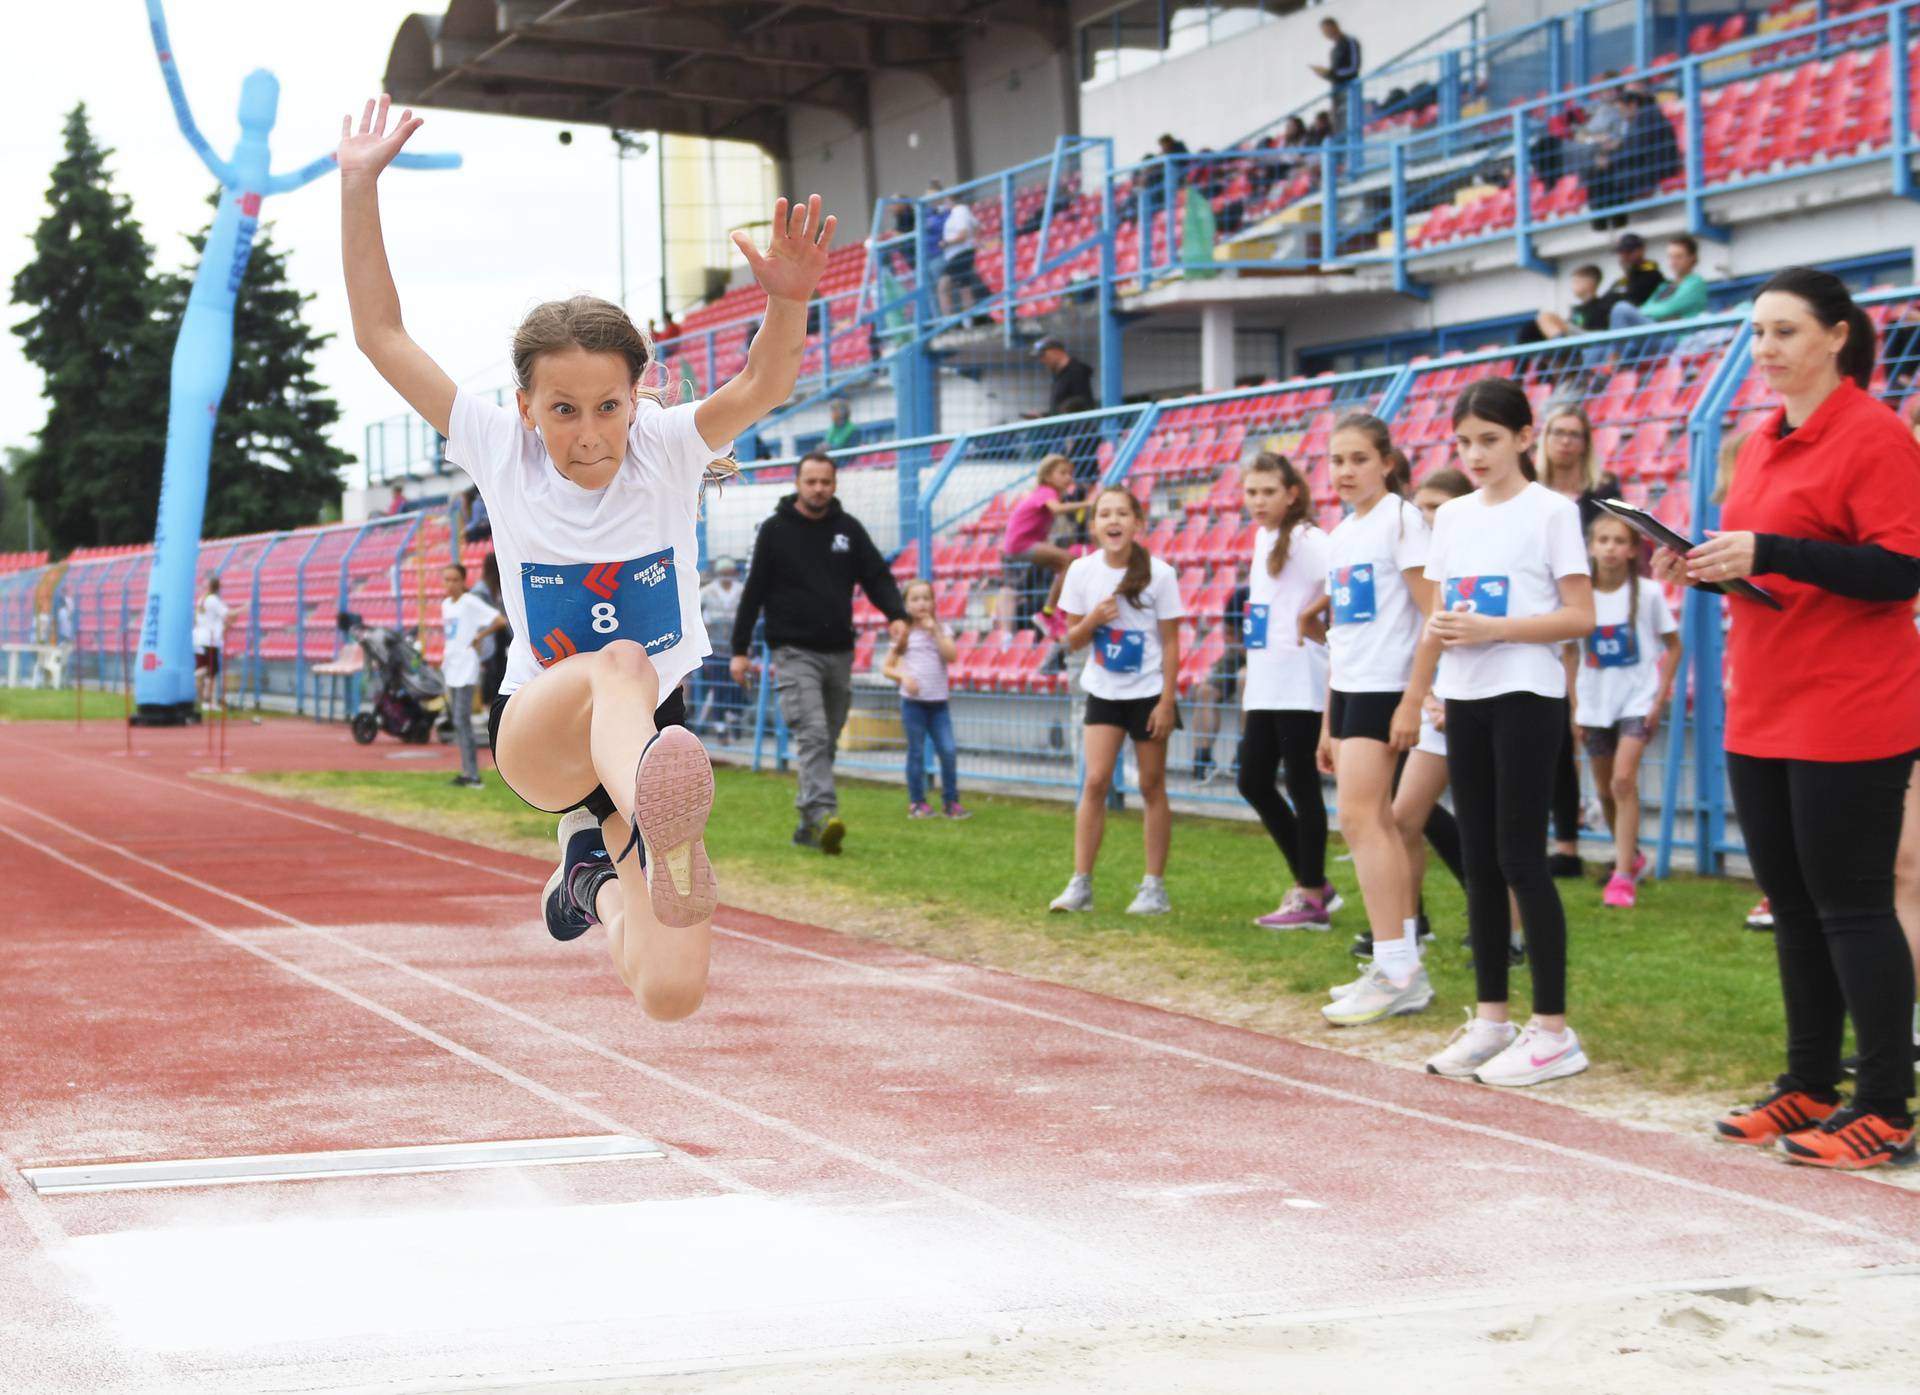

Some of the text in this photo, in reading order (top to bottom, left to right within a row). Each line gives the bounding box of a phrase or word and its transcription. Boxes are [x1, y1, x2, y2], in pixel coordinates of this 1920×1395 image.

[227, 222, 256, 293] ERSTE
[529, 575, 555, 585] ERSTE
[633, 562, 659, 581] ERSTE
[642, 566, 666, 584] PLAVA
[649, 573, 667, 588] LIGA
[591, 602, 619, 634] 8
[1106, 644, 1122, 659] 17
